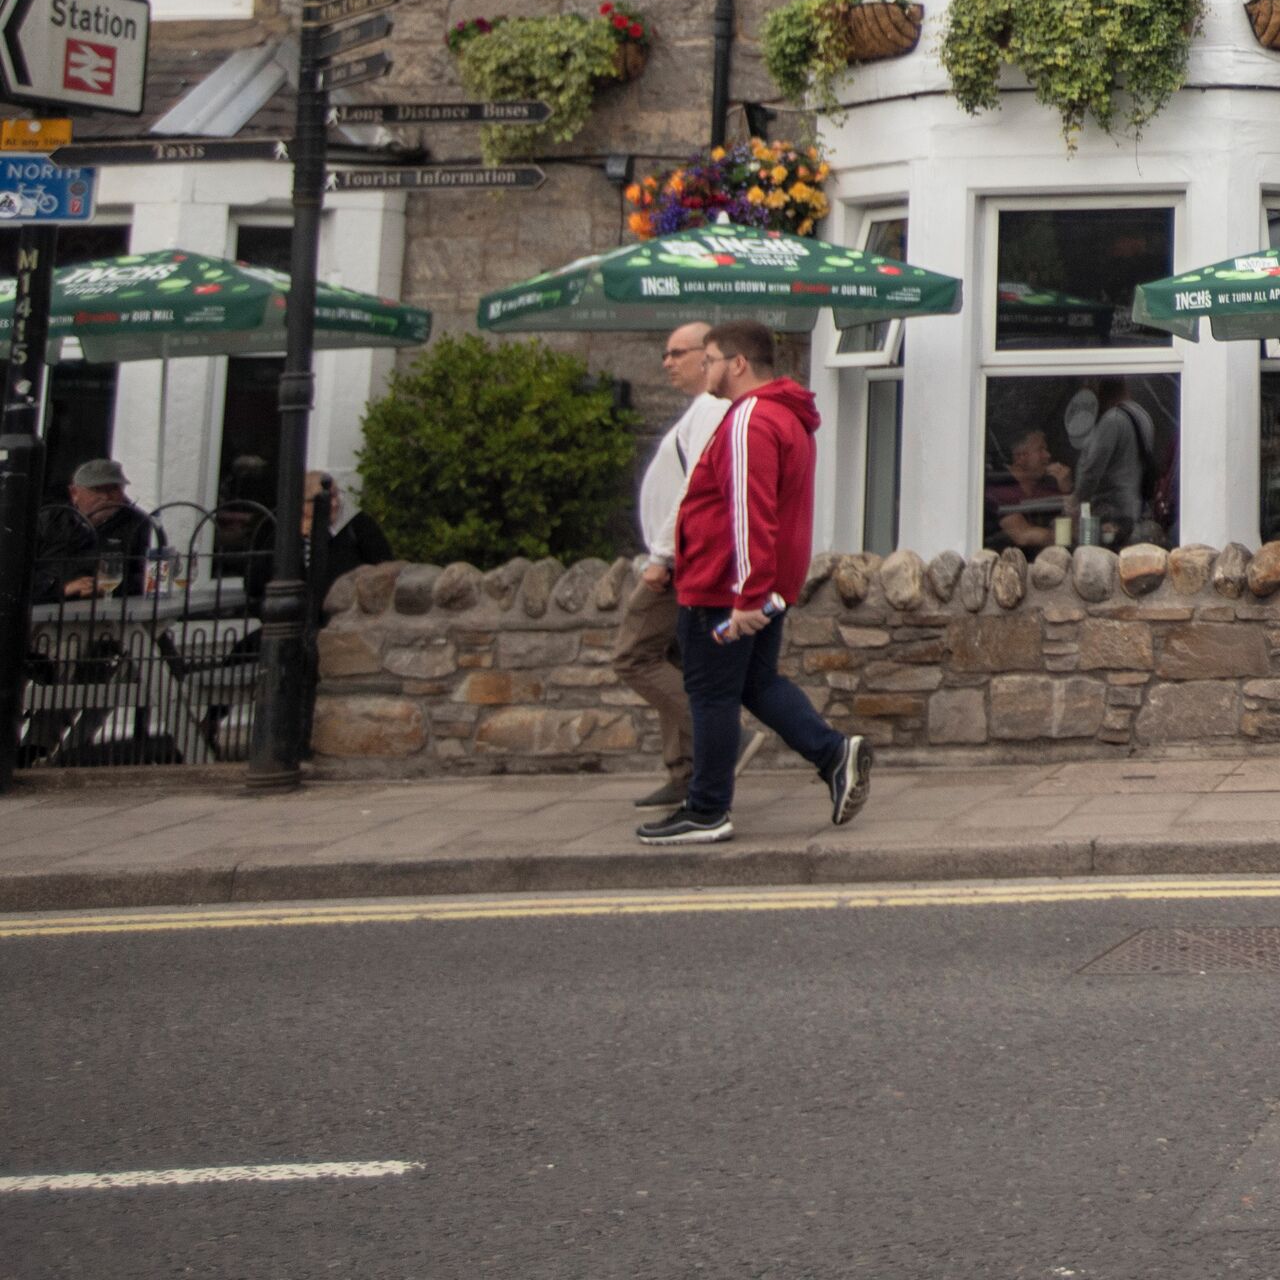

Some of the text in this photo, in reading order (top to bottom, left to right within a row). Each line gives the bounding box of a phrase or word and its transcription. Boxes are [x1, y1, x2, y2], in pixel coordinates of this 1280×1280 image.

[340, 104, 529, 122] Long Distance Buses
[152, 143, 205, 160] Taxis
[344, 169, 517, 187] Tourist Information
[734, 280, 767, 293] GROWN
[841, 285, 857, 296] OUR
[859, 285, 878, 297] MILL
[1218, 294, 1230, 304] WE
[1232, 292, 1252, 303] TURN
[1254, 291, 1267, 302] ALL
